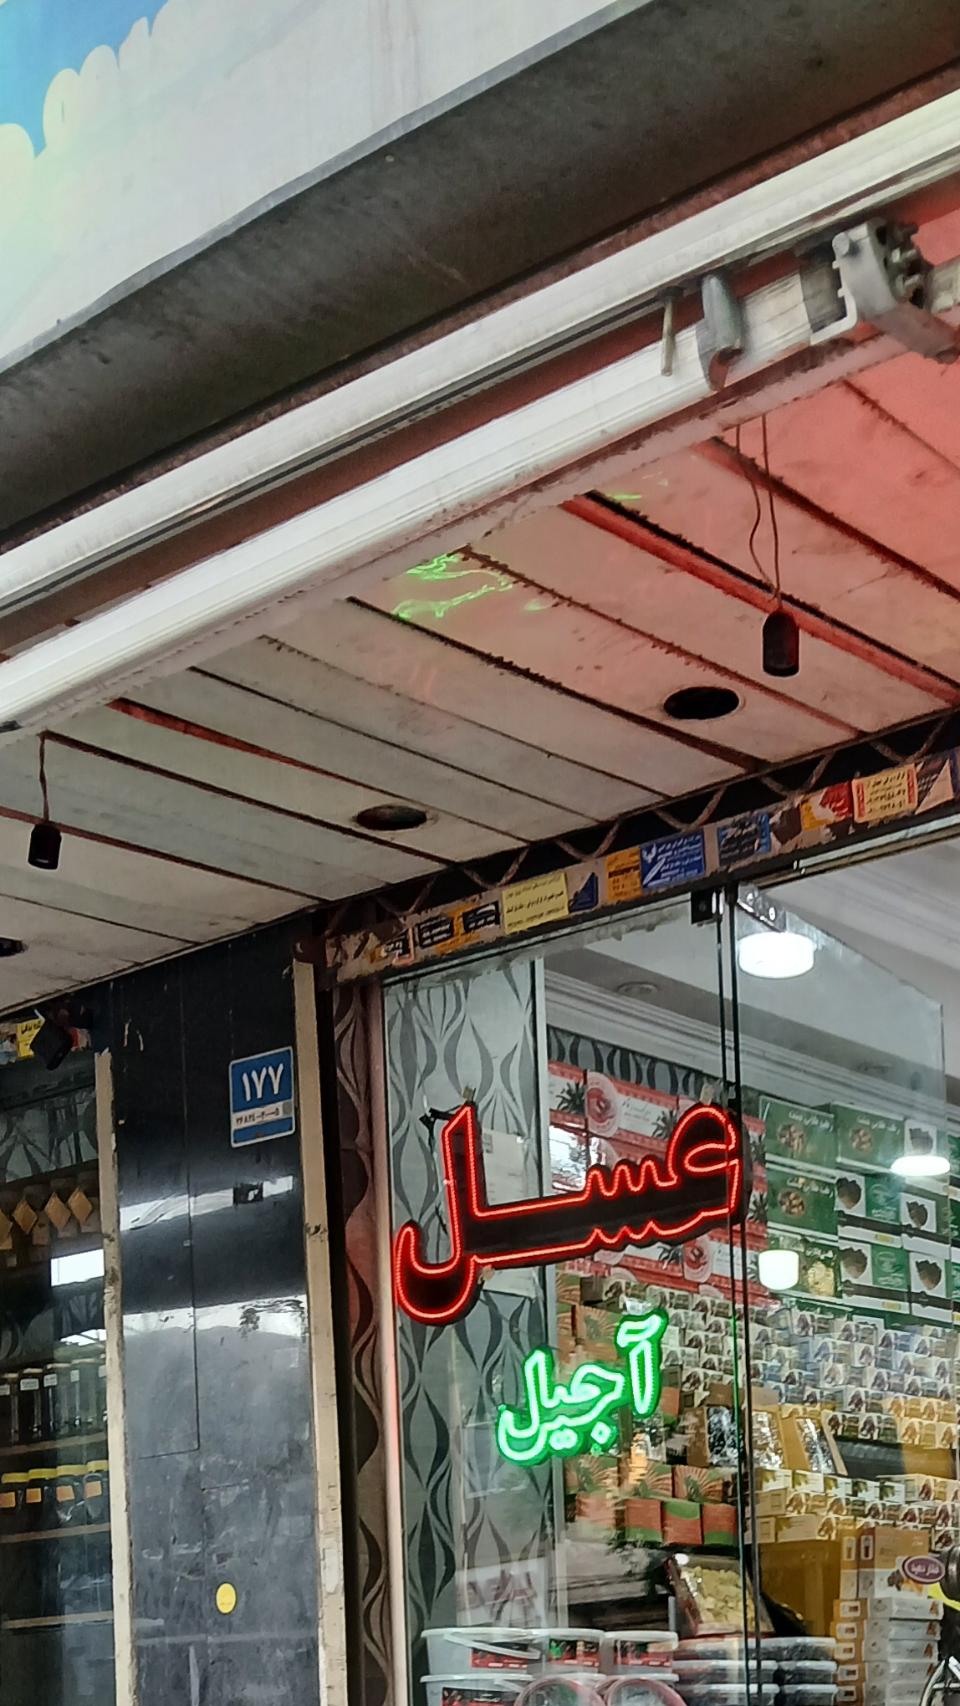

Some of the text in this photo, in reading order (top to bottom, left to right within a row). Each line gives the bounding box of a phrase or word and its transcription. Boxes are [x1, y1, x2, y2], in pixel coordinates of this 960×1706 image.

[241, 1063, 284, 1102] ۱۷۷
[394, 1102, 742, 1323] عسل
[497, 1309, 669, 1464] آجیل
